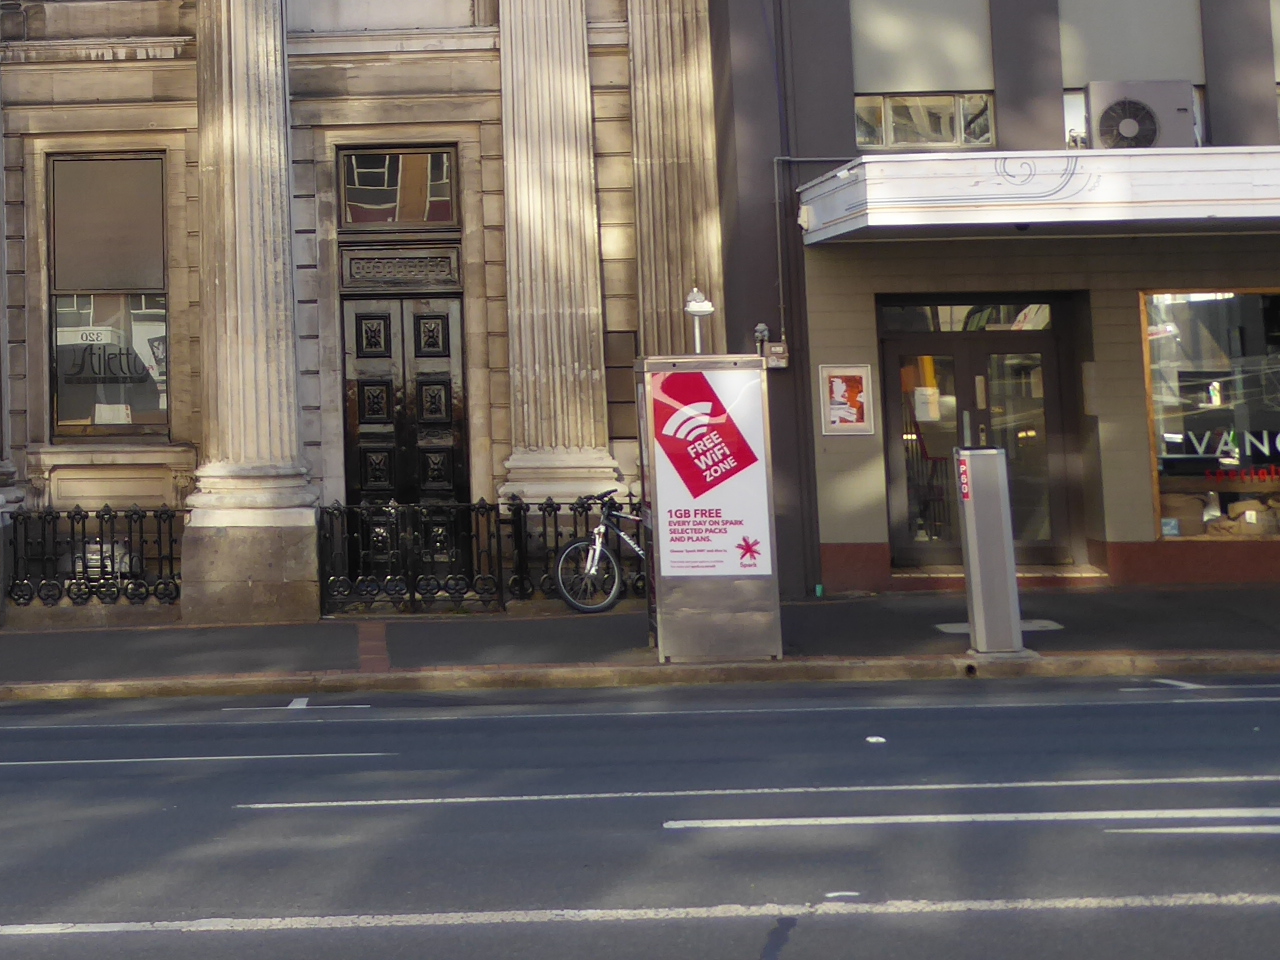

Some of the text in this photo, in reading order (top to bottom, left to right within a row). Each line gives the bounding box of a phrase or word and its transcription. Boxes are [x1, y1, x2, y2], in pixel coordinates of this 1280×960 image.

[63, 344, 148, 377] Stiletto
[687, 430, 722, 458] FREE
[693, 443, 731, 470] WiFi
[1187, 430, 1280, 456] VAN
[702, 456, 738, 482] ZONE
[960, 465, 968, 493] P60
[667, 508, 722, 519] 1GB FREE
